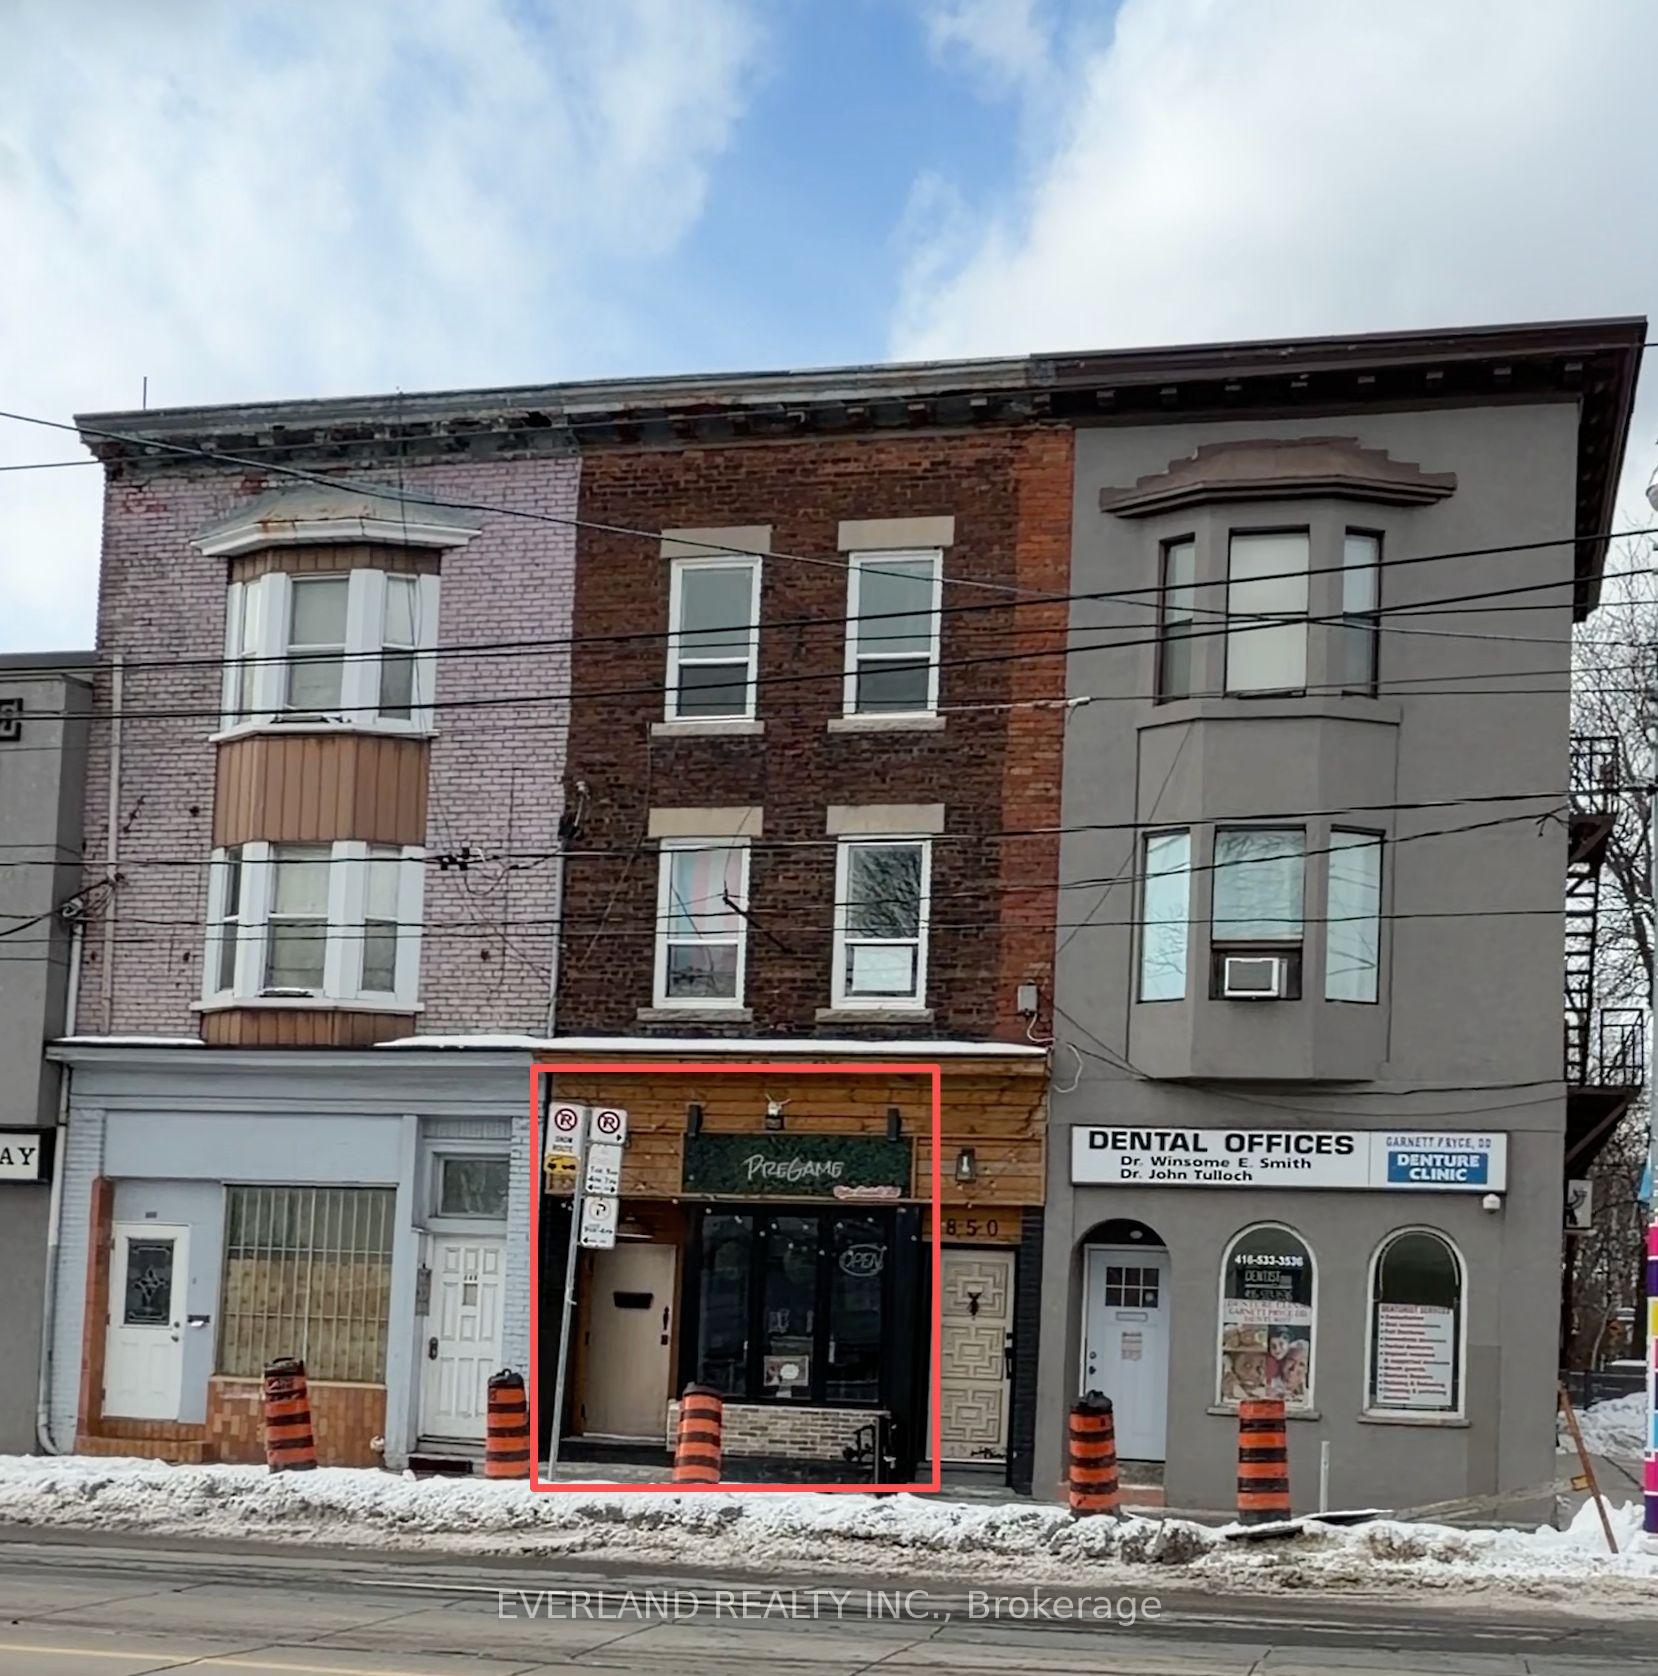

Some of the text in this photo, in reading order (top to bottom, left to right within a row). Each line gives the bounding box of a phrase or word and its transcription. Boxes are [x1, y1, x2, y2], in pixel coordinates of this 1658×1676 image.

[1088, 1130, 1355, 1155] DENTAL OFFICES
[1386, 1136, 1435, 1148] GARNETT
[0, 1146, 36, 1166] AY
[1120, 1155, 1312, 1170] Dr. Winsome E. Smith
[1396, 1153, 1480, 1168] DENTURE
[1120, 1168, 1253, 1182] Dr. John Tulloch
[1408, 1167, 1468, 1181] CLINIC
[946, 1218, 999, 1237] 850
[845, 1251, 883, 1270] OPEN
